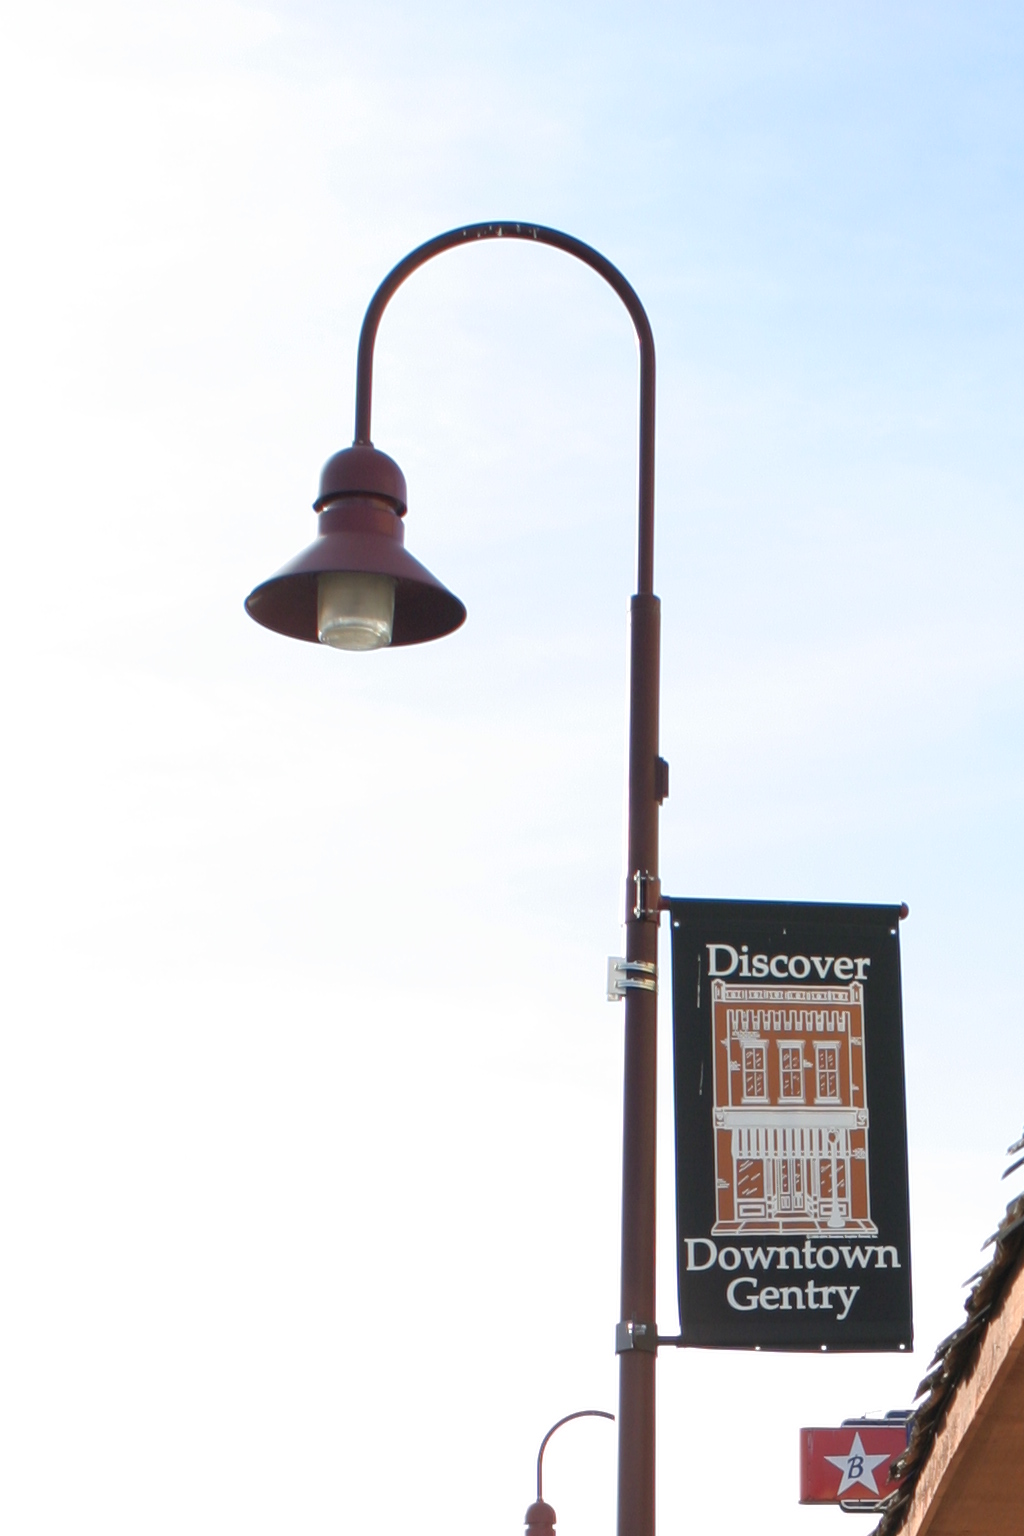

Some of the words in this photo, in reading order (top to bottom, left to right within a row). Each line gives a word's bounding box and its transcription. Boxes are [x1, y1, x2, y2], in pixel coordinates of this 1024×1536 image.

[706, 943, 871, 981] Discover
[684, 1237, 902, 1272] Downtown
[726, 1276, 861, 1320] Gentry
[847, 1453, 865, 1480] B
